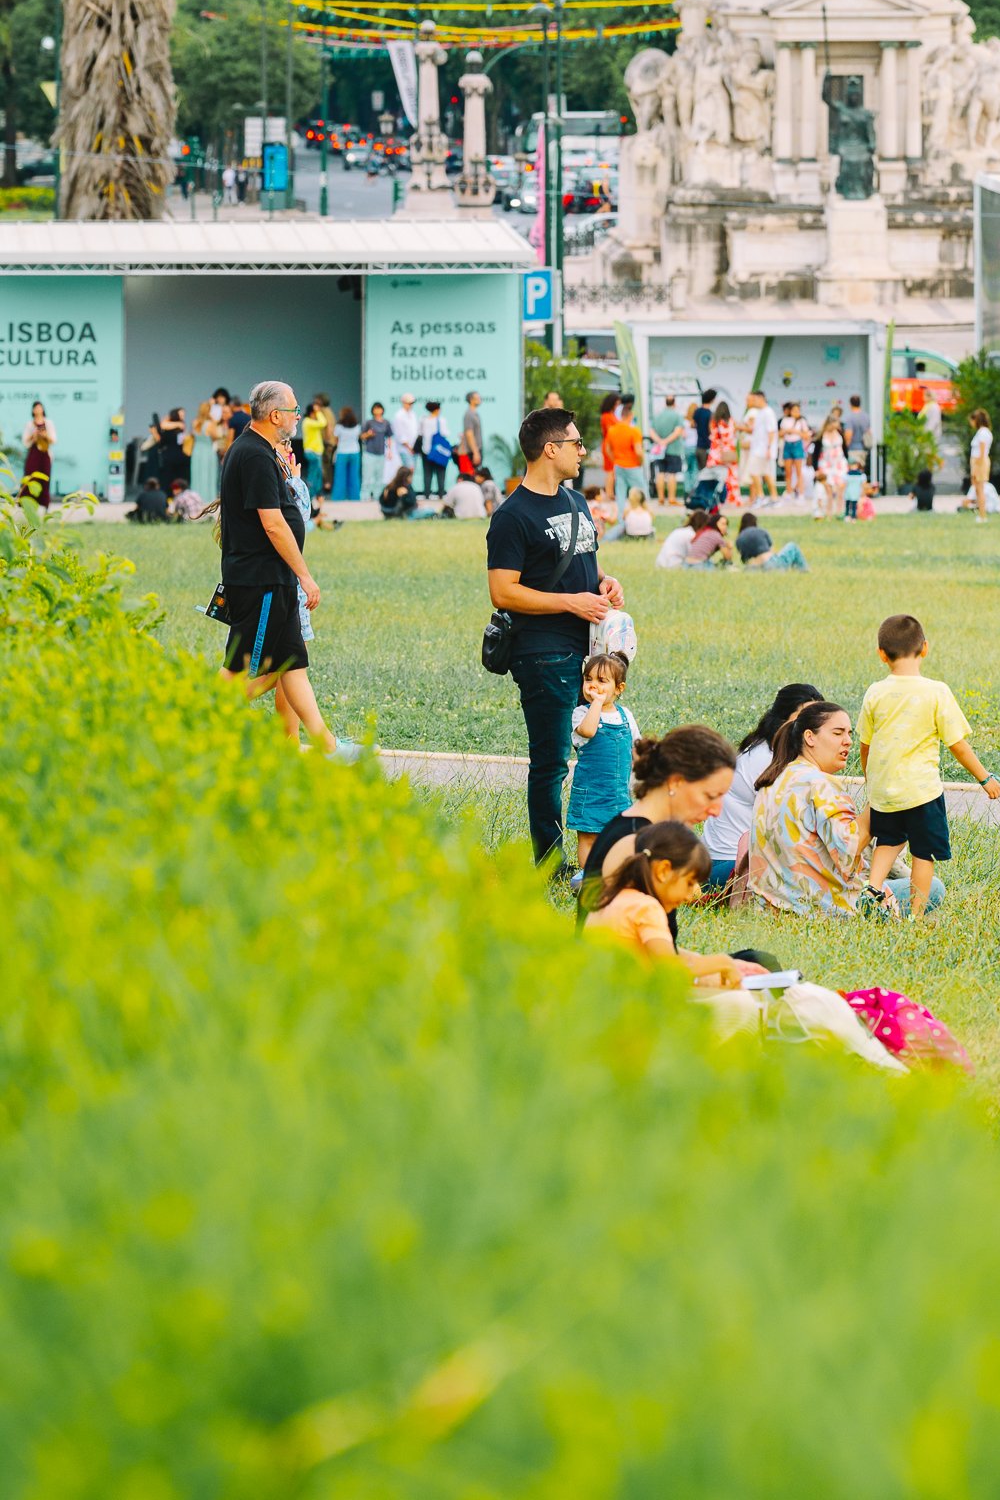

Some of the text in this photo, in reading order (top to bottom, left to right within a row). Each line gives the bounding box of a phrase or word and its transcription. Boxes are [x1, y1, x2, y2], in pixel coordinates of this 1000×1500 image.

[528, 278, 547, 314] P
[0, 322, 97, 343] ISBOA
[390, 320, 496, 338] As pessoas
[390, 341, 463, 357] fazem a
[390, 365, 487, 381] biblioteca
